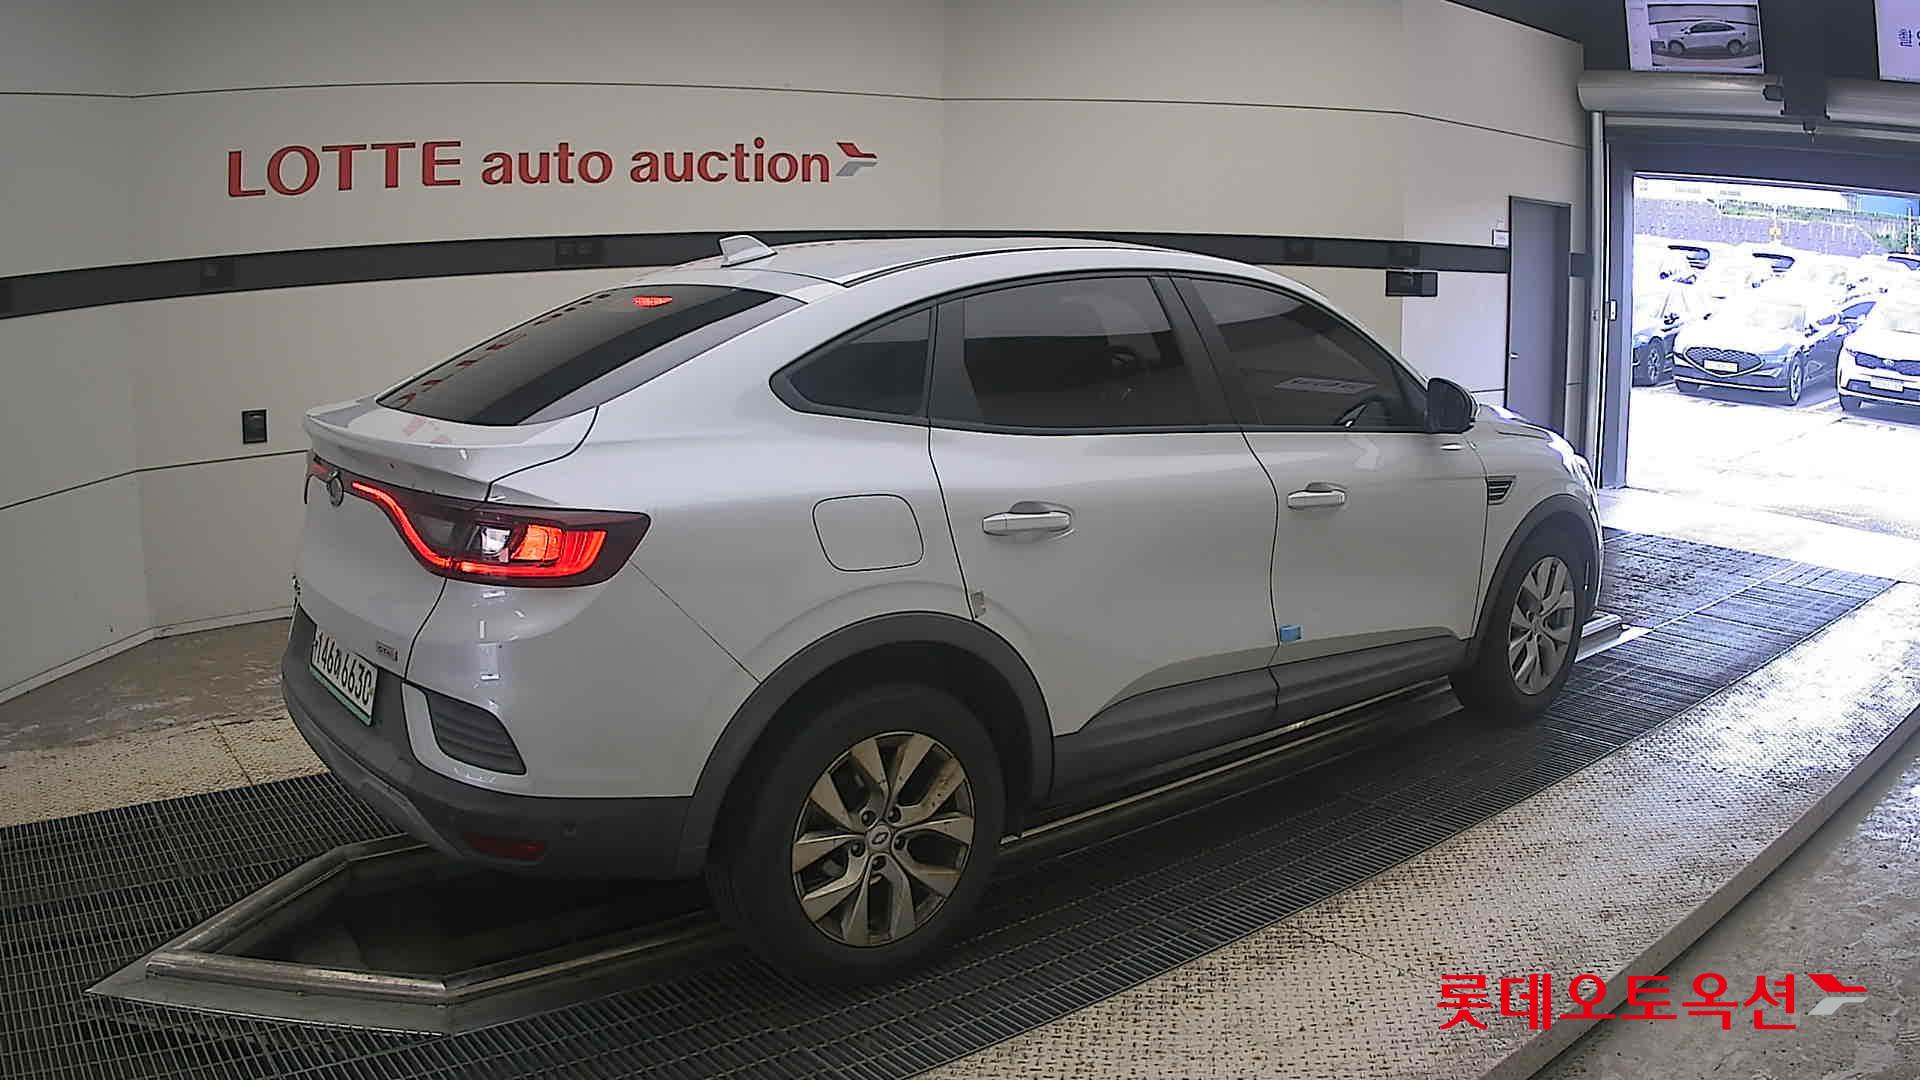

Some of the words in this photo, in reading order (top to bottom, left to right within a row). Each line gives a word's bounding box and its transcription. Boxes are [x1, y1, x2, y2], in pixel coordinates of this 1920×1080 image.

[227, 141, 460, 197] LOTTE
[480, 142, 614, 186] auto
[629, 138, 832, 183] auction
